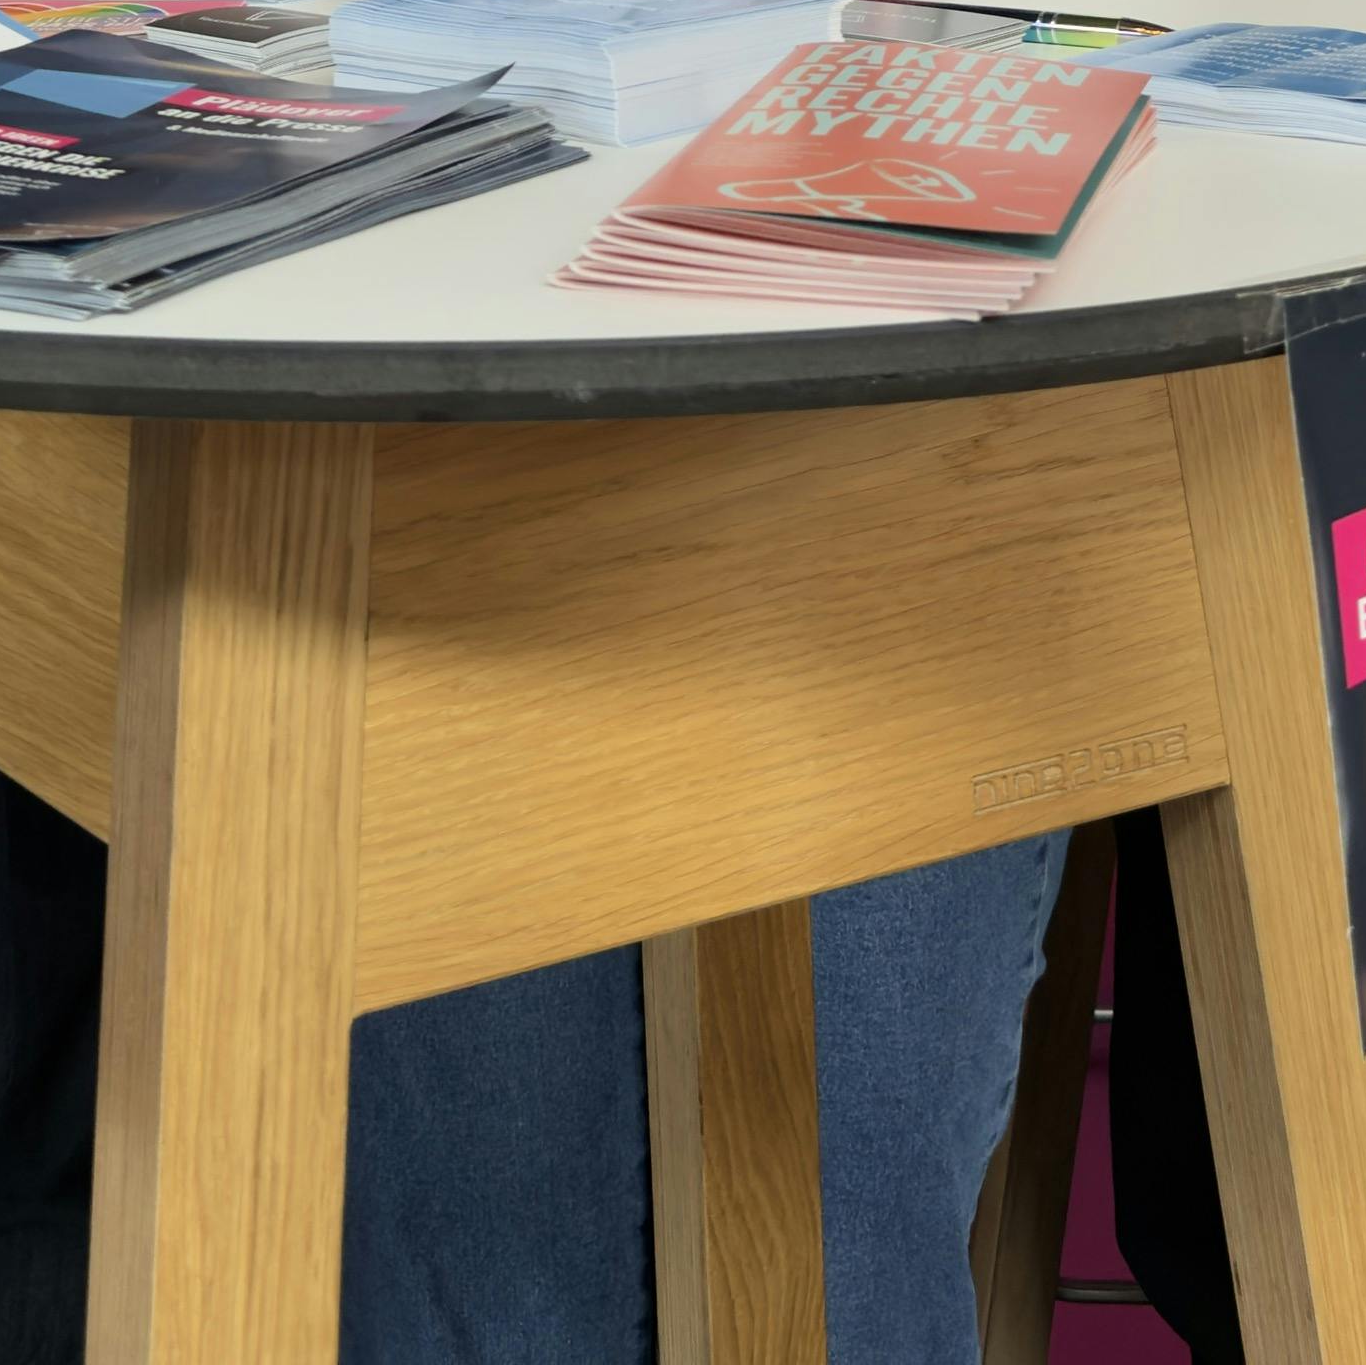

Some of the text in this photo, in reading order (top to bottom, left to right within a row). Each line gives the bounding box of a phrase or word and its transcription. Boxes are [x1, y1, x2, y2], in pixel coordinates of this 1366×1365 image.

[781, 63, 1032, 103] GEGEN
[803, 43, 1092, 87] FAKTEN
[157, 108, 364, 132] an die Presse
[192, 96, 373, 117] Plädoyer
[752, 85, 1060, 130] RECHTE
[724, 110, 1072, 156] MYTHEN
[52, 153, 113, 166] DIE
